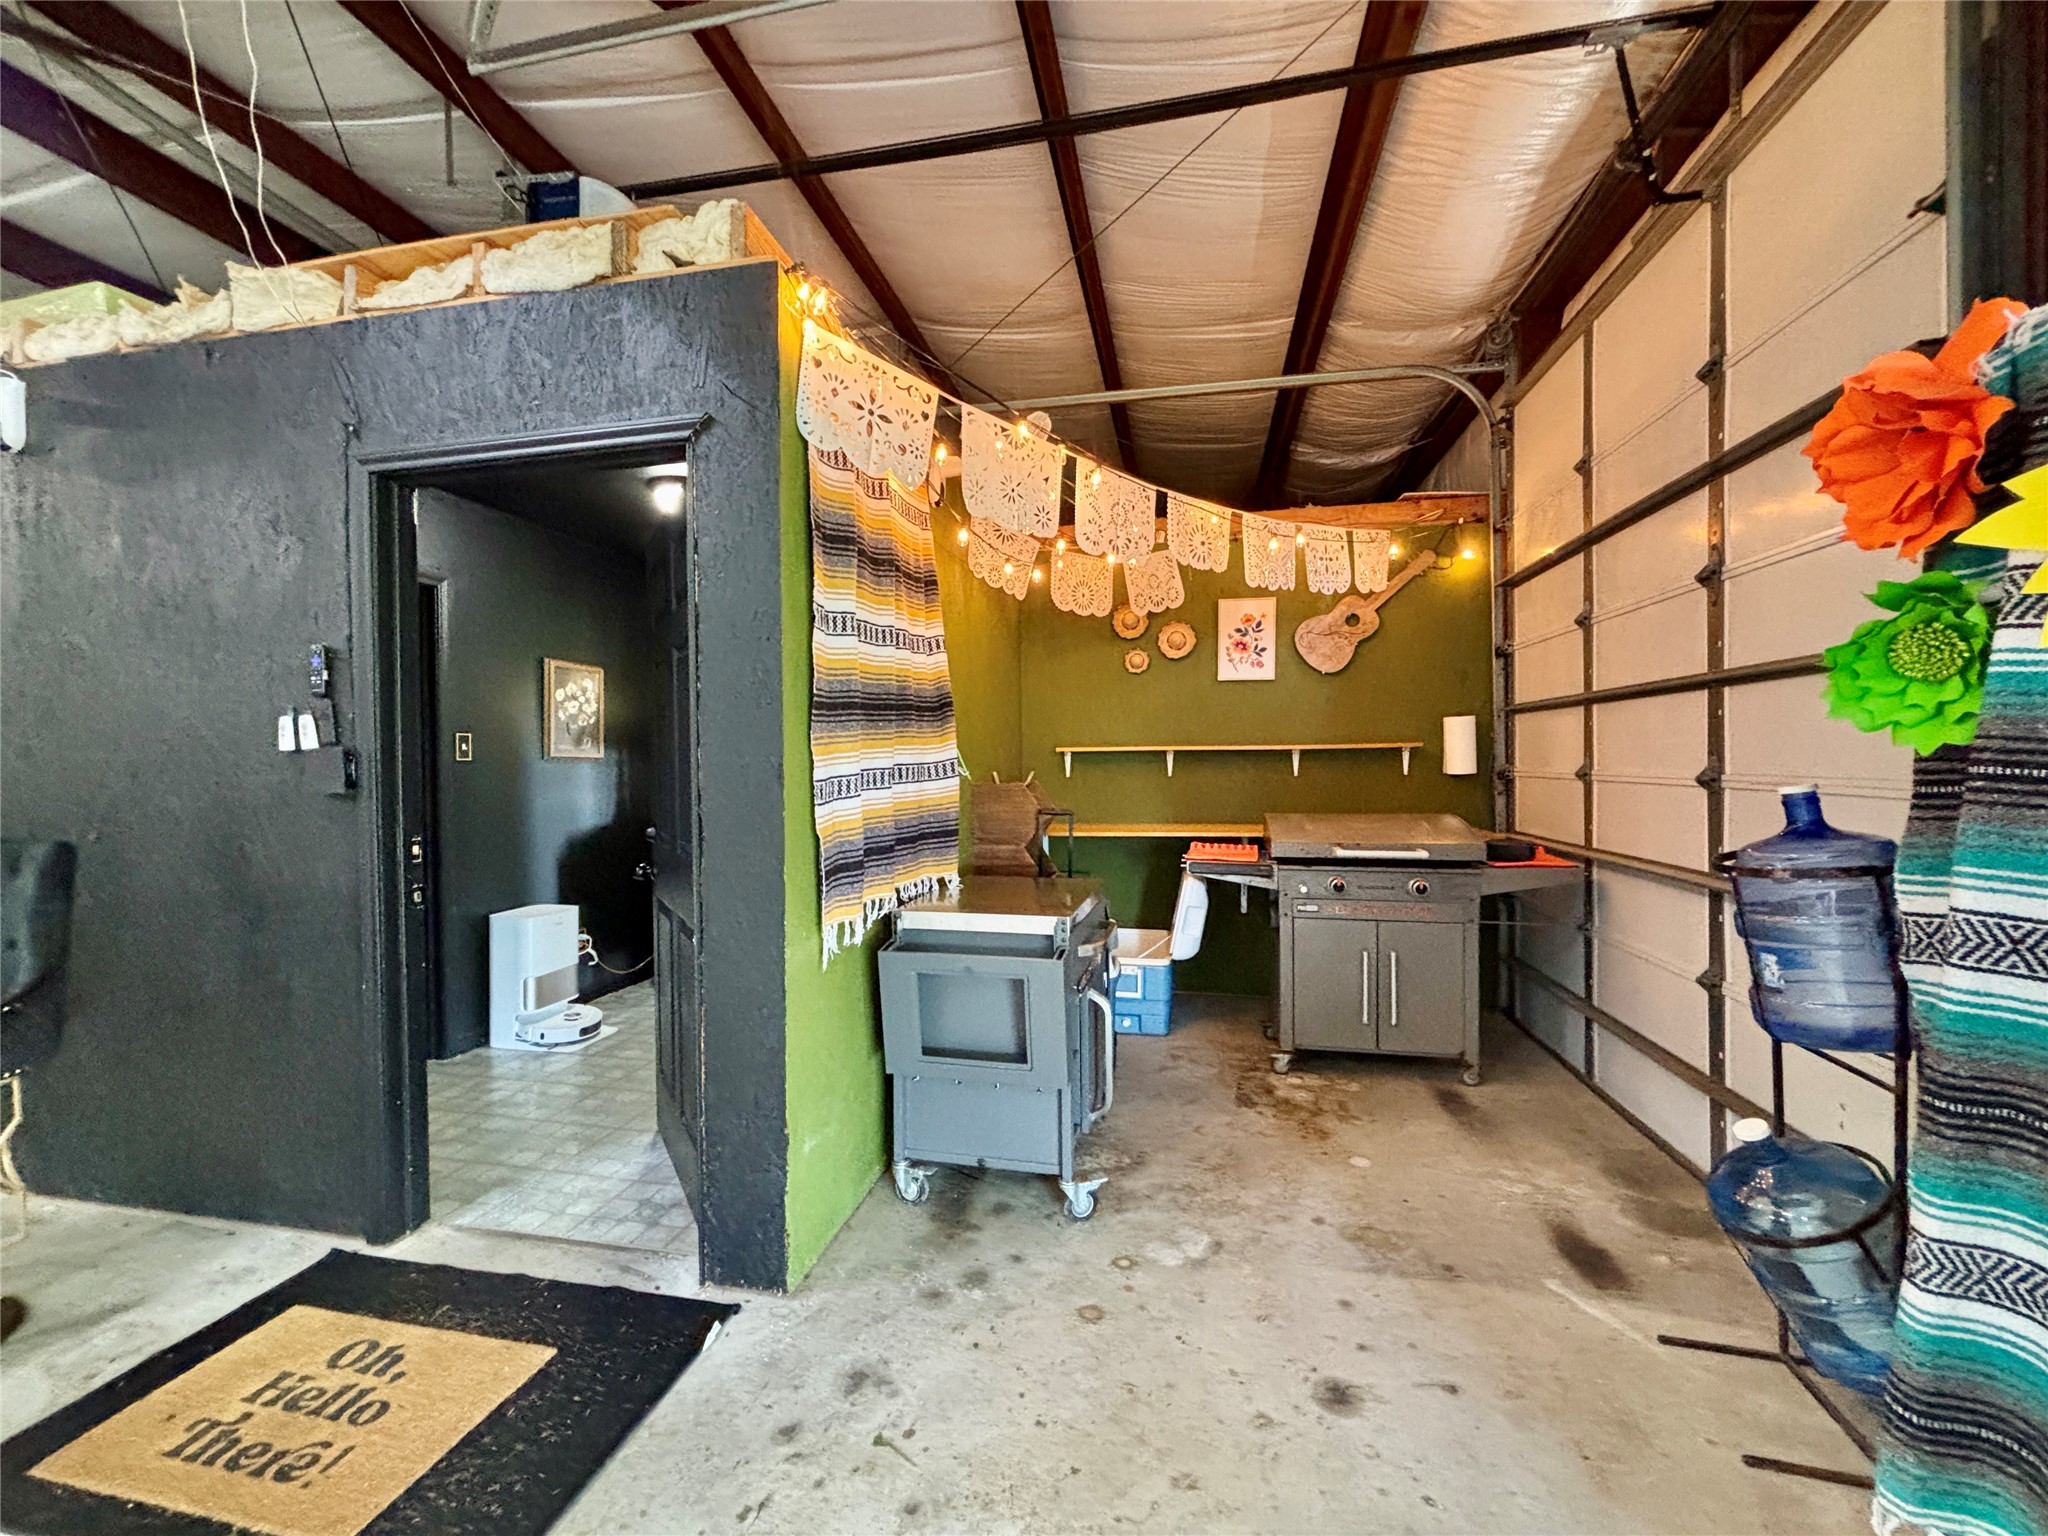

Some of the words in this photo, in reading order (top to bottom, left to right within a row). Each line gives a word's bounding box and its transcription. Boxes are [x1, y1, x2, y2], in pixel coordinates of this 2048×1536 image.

[327, 1339, 406, 1384] Oh,
[240, 1370, 391, 1427] Hello
[162, 1411, 356, 1488] There!
